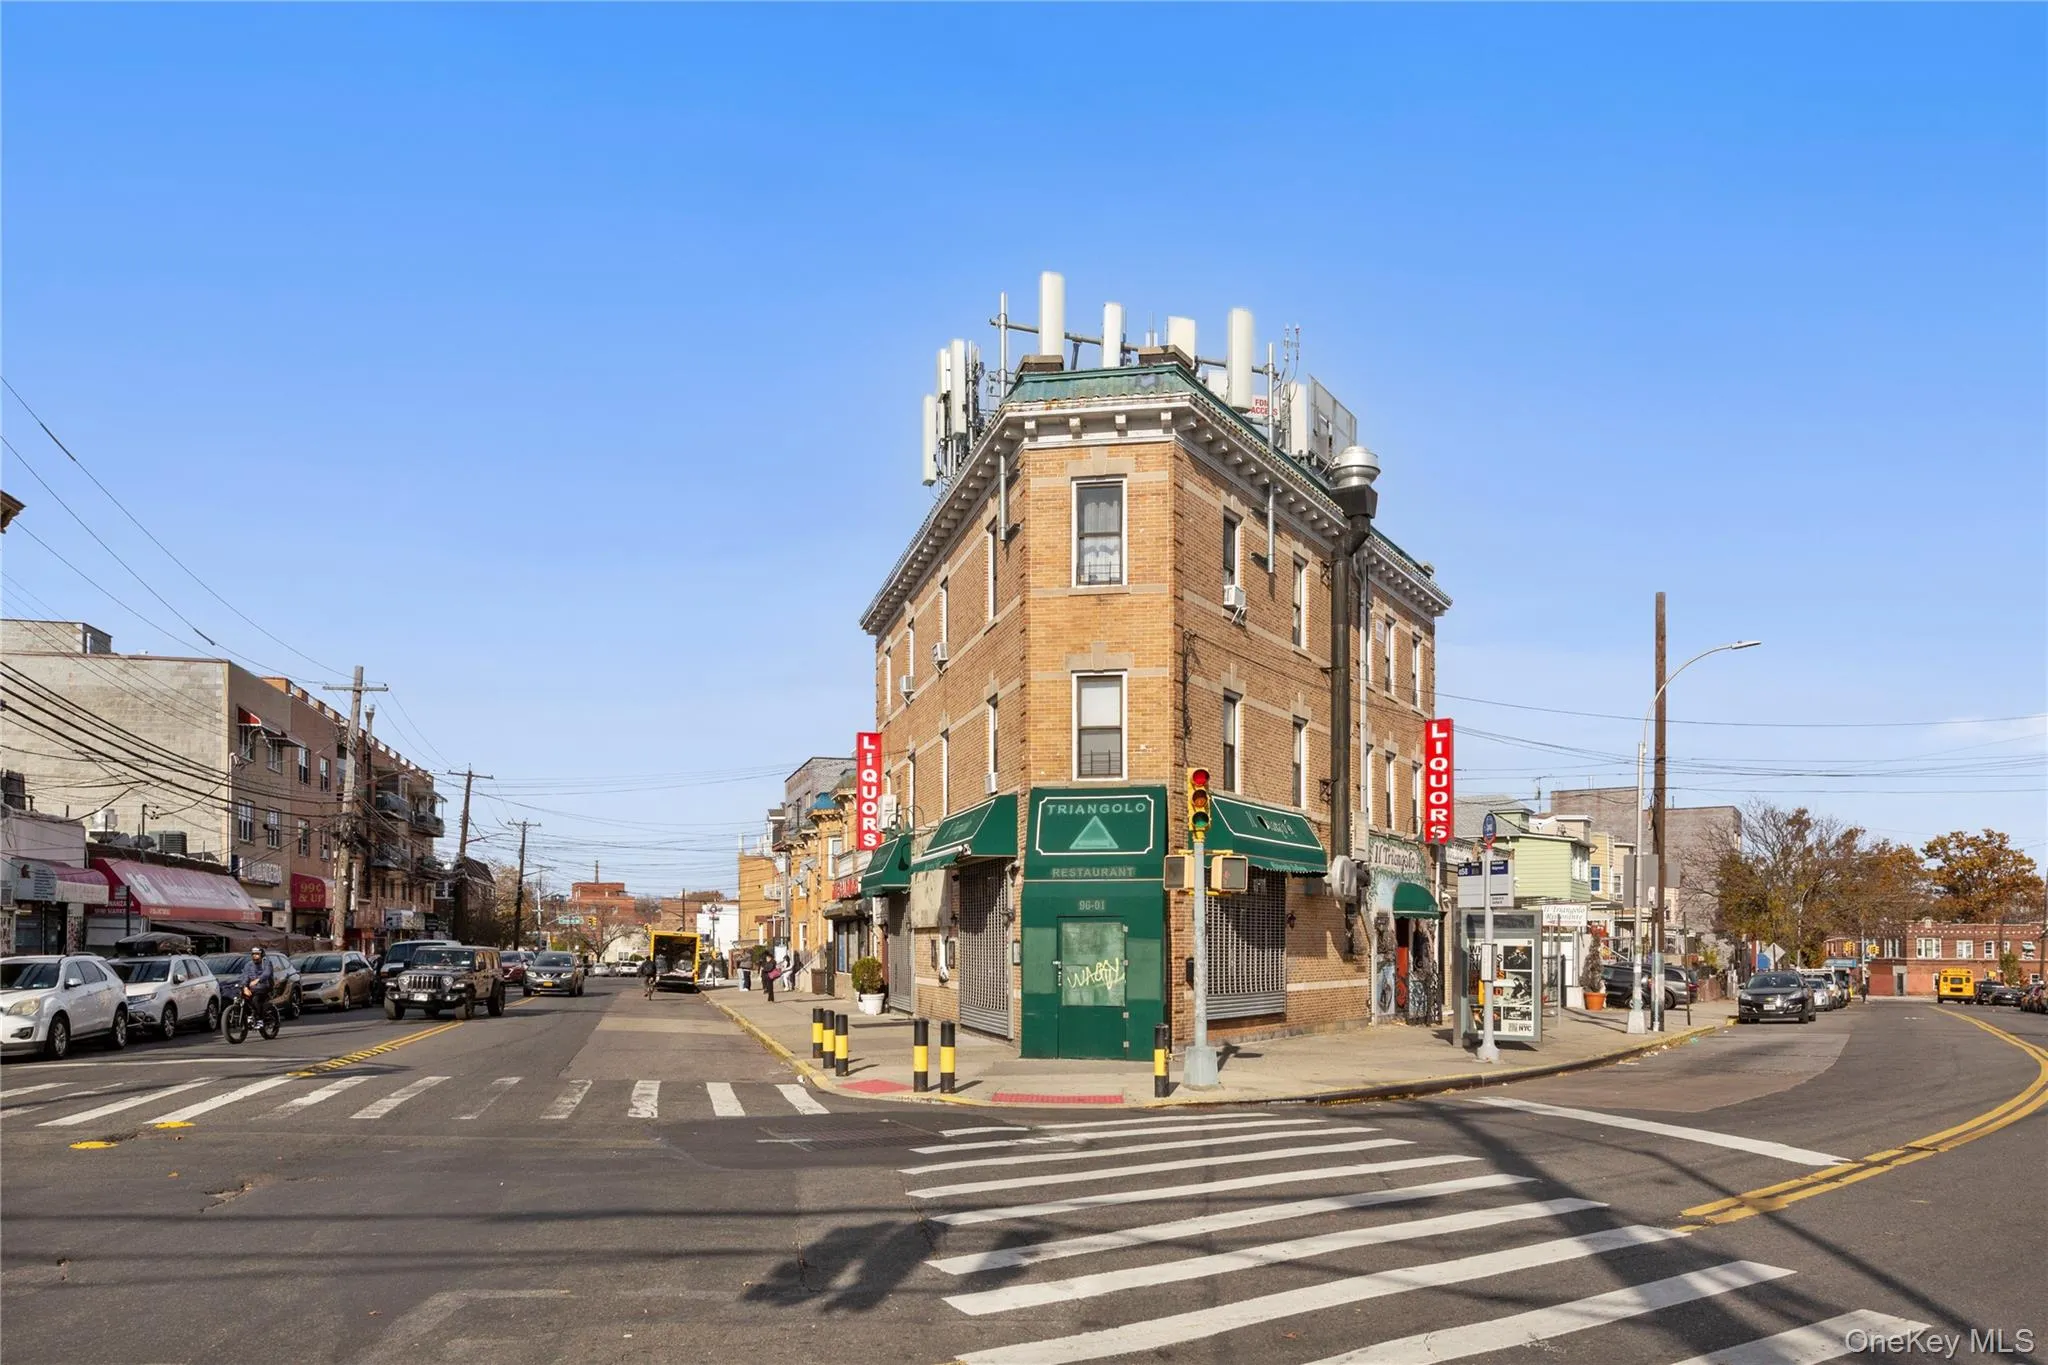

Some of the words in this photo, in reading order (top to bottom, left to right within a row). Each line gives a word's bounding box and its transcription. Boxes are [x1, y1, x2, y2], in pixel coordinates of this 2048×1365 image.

[1250, 407, 1278, 416] ACCES
[1429, 722, 1448, 839] LIQUORS
[861, 735, 877, 847] LIQUORS
[1047, 802, 1146, 815] TRIANGOLO
[1383, 847, 1415, 874] Triangolo
[1051, 866, 1136, 878] RESTAURANT
[310, 894, 325, 903] UP
[1079, 900, 1105, 911] 96-01
[1518, 1024, 1533, 1032] NYC
